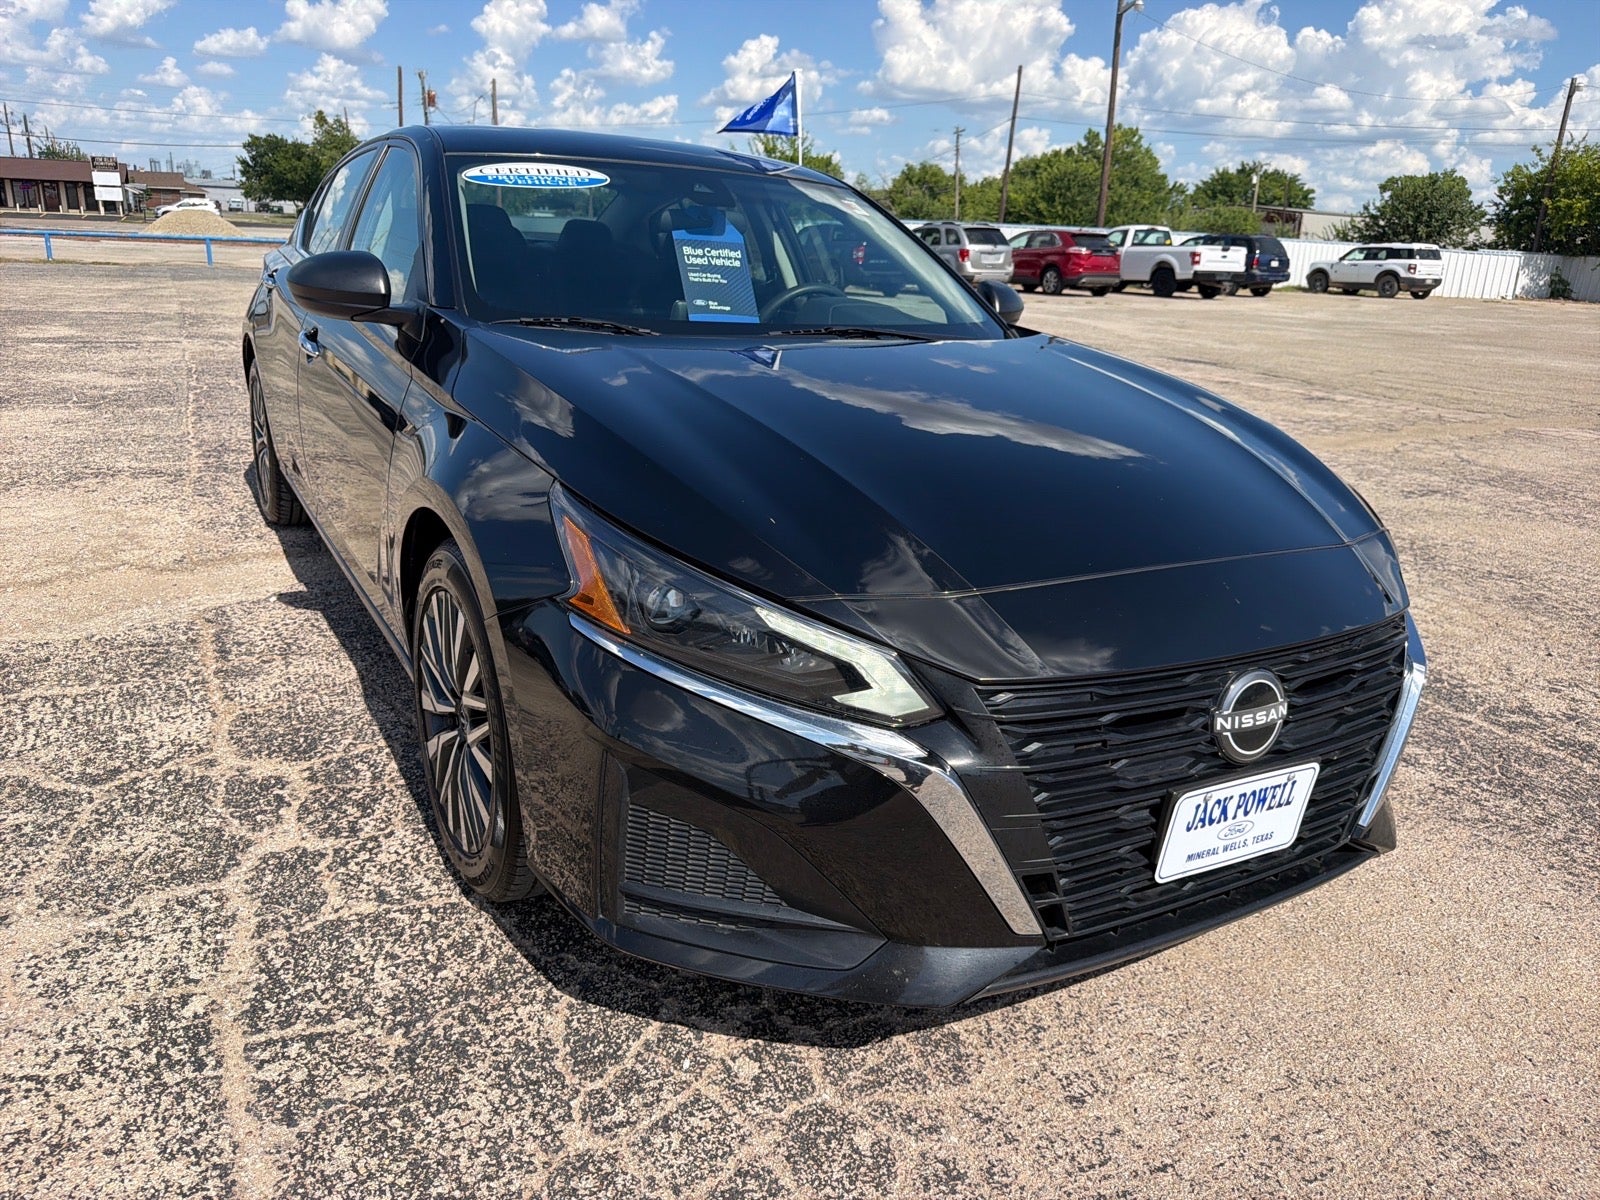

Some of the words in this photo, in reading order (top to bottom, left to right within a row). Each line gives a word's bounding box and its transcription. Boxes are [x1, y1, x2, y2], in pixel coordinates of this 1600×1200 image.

[479, 167, 591, 177] CERTIFIED
[487, 175, 590, 183] PRE-OWNED
[504, 178, 578, 186] VEHICLE
[682, 246, 704, 255] Blue
[704, 247, 742, 258] Certified
[684, 255, 708, 265] Used
[709, 257, 741, 267] Vehicle
[1216, 702, 1288, 731] NISSAN
[1185, 795, 1234, 833] JACK
[1232, 780, 1297, 821] POWELL
[1224, 823, 1248, 838] Ford
[1185, 846, 1220, 864] MINERAL
[1222, 838, 1249, 854] WELLS,
[1252, 831, 1274, 845] TEXAS
